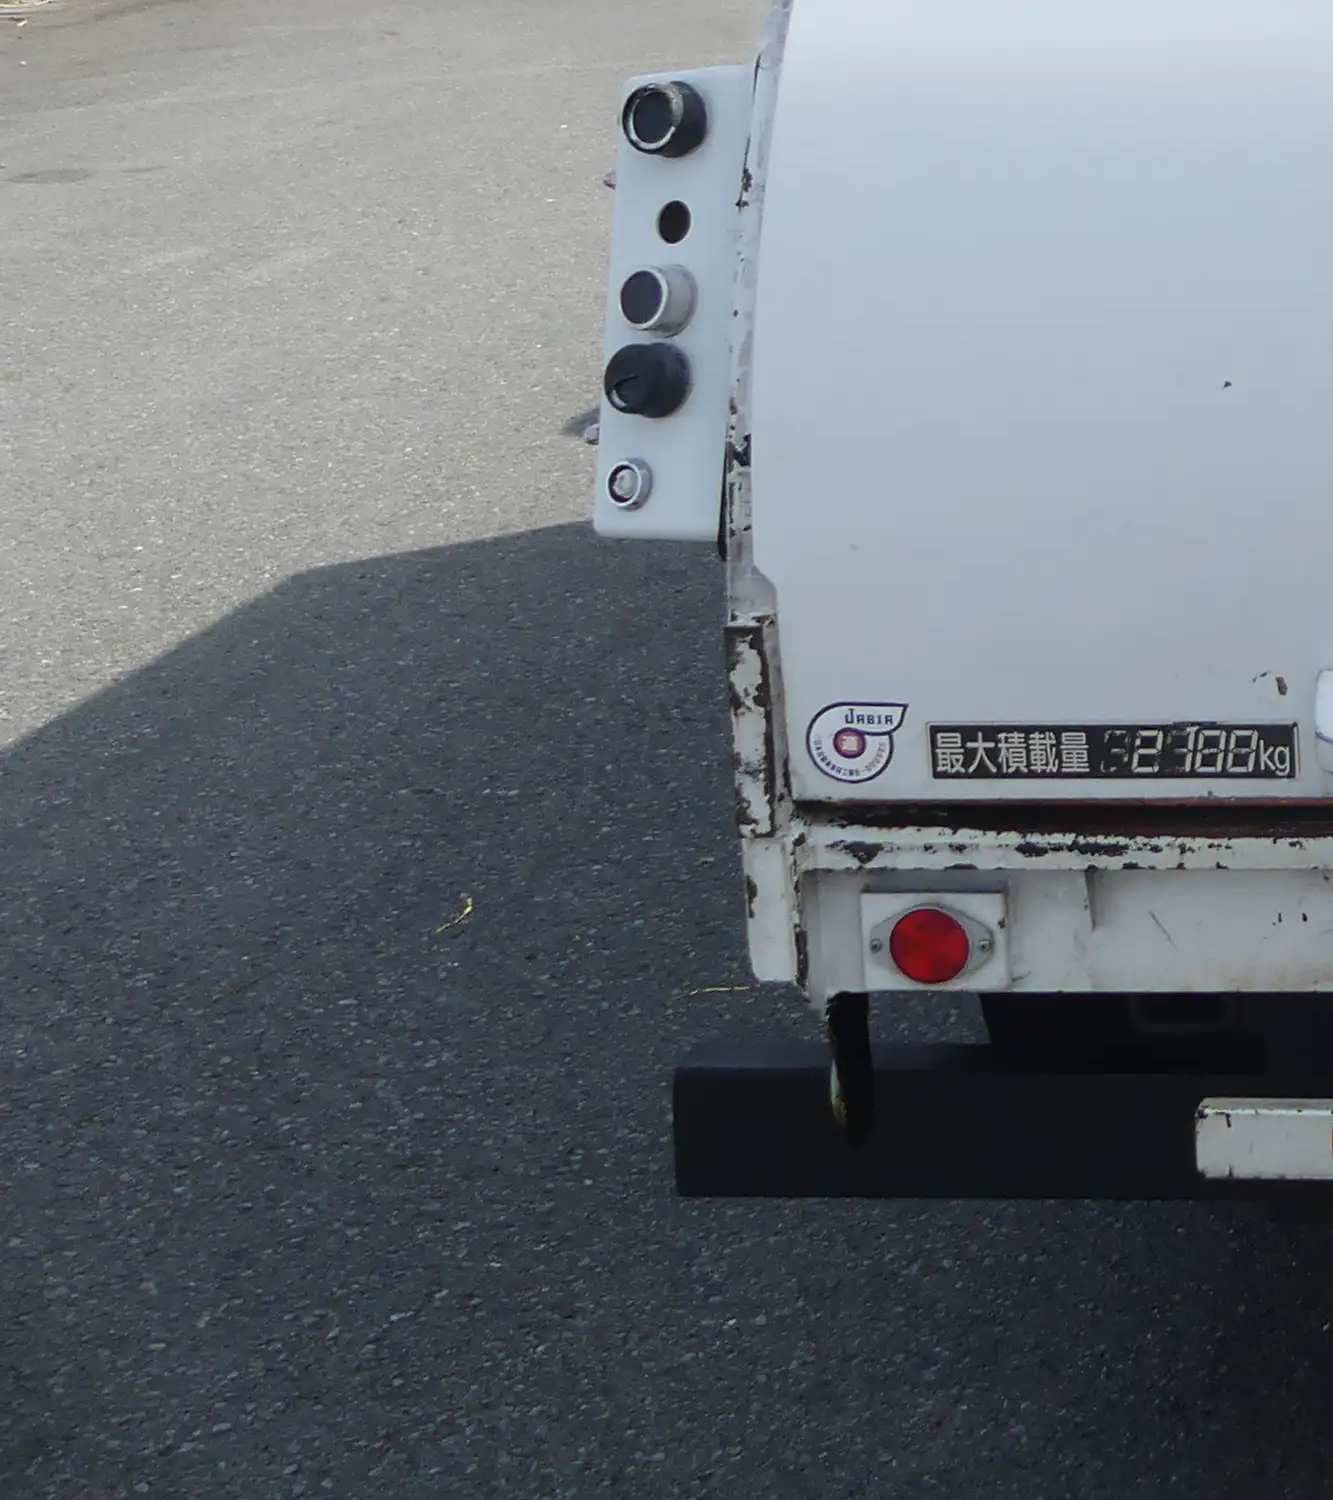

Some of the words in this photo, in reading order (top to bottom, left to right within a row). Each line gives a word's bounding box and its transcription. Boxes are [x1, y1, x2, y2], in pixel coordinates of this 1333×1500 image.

[844, 708, 894, 725] JABIA
[934, 730, 1091, 774] 最大積載量
